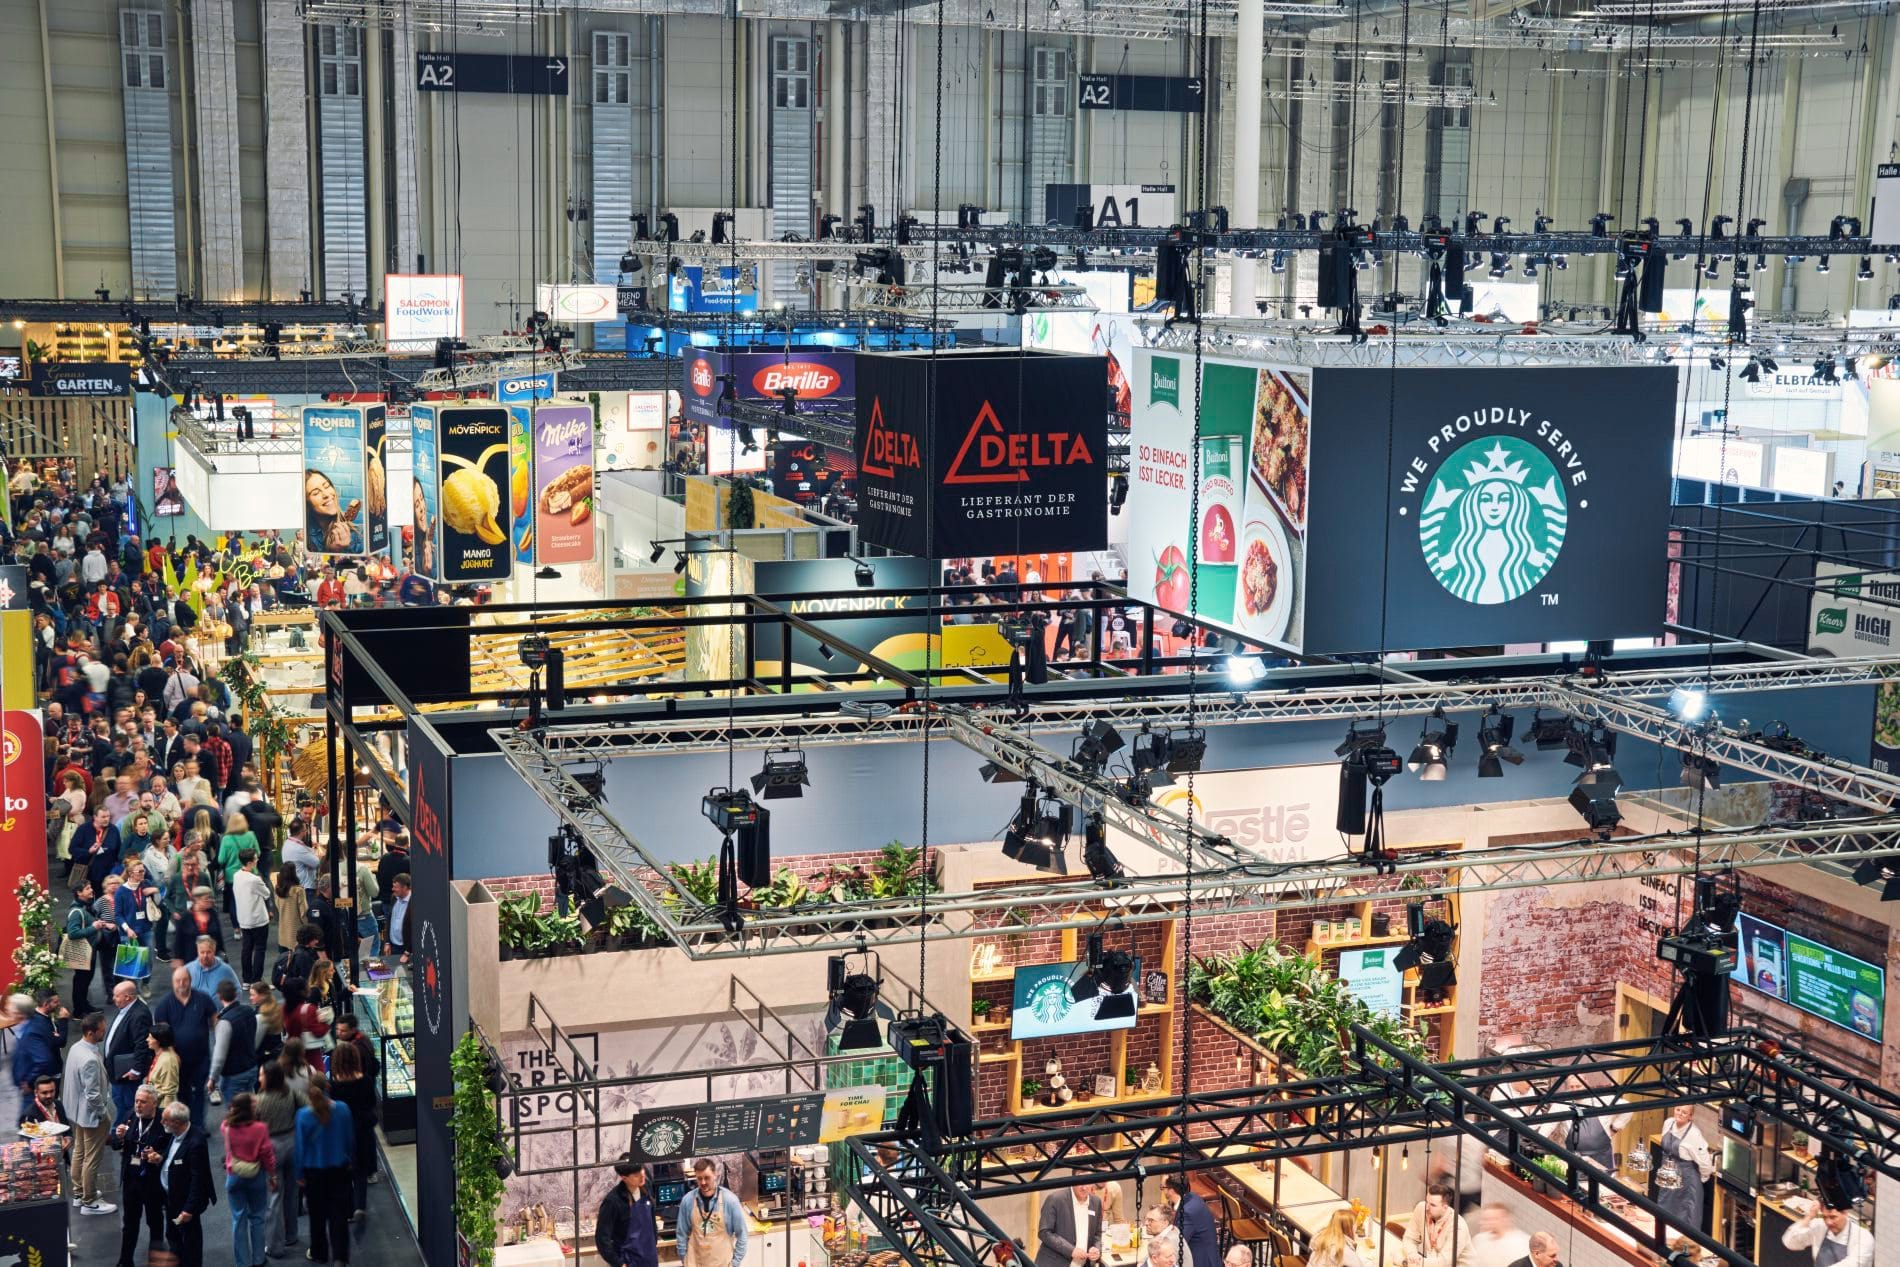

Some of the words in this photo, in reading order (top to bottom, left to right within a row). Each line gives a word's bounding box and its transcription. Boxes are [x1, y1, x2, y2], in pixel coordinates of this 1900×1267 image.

[419, 64, 454, 86] A2
[1081, 84, 1110, 105] A2
[1880, 166, 1898, 176] Halle
[1097, 195, 1140, 227] A1
[399, 299, 450, 308] SALOMON
[56, 378, 114, 391] GARTEN
[505, 378, 548, 394] OREO
[693, 367, 711, 388] Barilla
[763, 371, 831, 390] Barilla
[1153, 372, 1176, 390] Buitoni
[309, 416, 356, 432] FRONERI
[448, 423, 502, 435] MÖVENPICK
[541, 418, 589, 448] Milka
[873, 428, 921, 469] DELTA
[980, 432, 1094, 468] DELTA
[1139, 445, 1150, 461] SO
[1152, 447, 1187, 469] EINFACH
[1205, 449, 1228, 465] Buitoni
[1400, 456, 1428, 494] WE
[1427, 407, 1532, 453] PROUDLY
[1537, 420, 1588, 487] SERVE
[1139, 465, 1154, 482] ISST
[1155, 468, 1187, 490] LECKER.
[867, 486, 900, 502] LIEFERANT
[901, 494, 914, 504] DER
[961, 494, 1042, 507] LIEFERANT
[1048, 493, 1076, 503] DER
[966, 506, 1071, 519] GASTRONOMIE
[463, 548, 491, 559] MANGO
[460, 558, 495, 570] JOGHURT
[233, 564, 266, 591] Bar
[1540, 593, 1559, 606] TM
[1819, 612, 1844, 628] Knorr
[1855, 613, 1891, 637] HIGH
[1640, 894, 1657, 912] ISST
[970, 943, 1003, 977] Coffee
[1026, 986, 1035, 1000] WE
[1034, 974, 1064, 988] PROUDLY
[517, 1049, 557, 1069] THE
[643, 1115, 675, 1128] PROUDLY
[675, 1116, 691, 1131] SERVE
